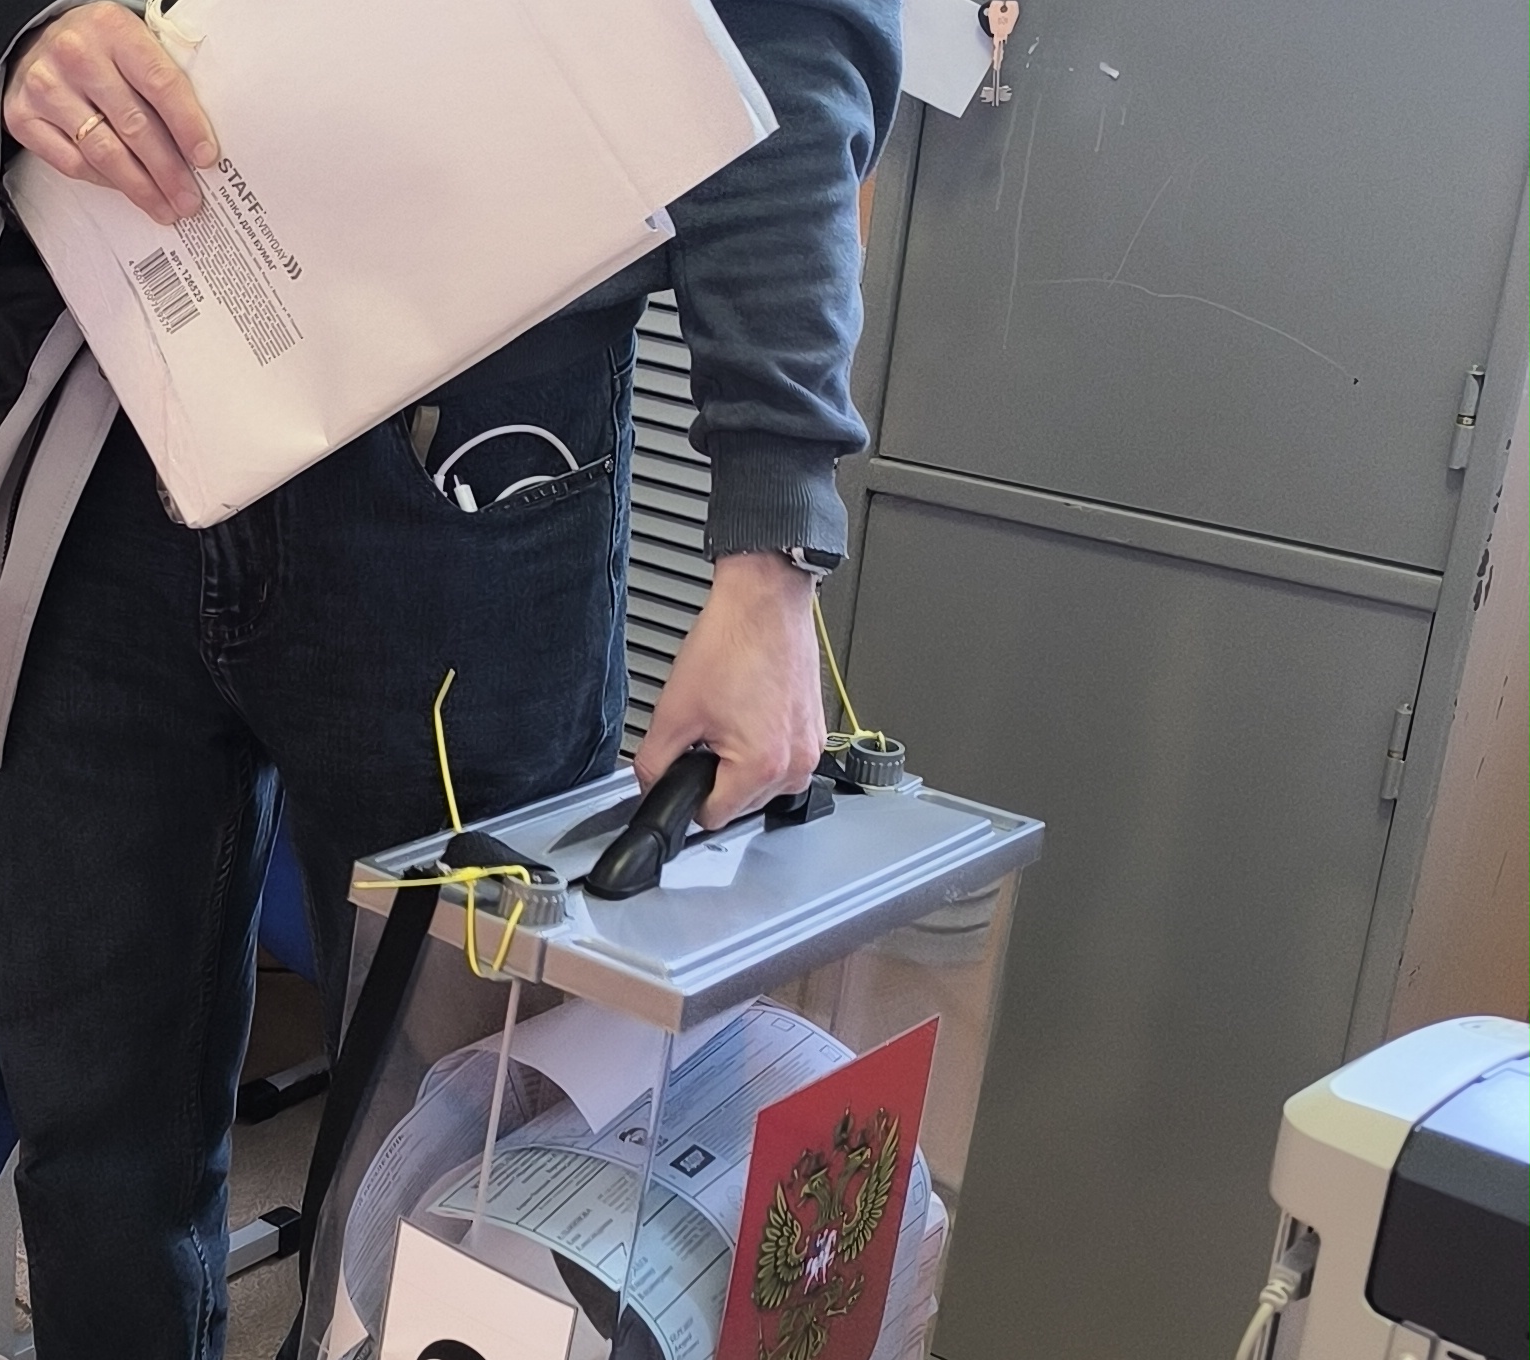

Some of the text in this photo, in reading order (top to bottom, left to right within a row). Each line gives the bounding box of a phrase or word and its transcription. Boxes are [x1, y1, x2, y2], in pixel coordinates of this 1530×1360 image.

[218, 158, 264, 214] STAFF
[219, 186, 277, 271] ПАПКА ДЛЯ БУМАГ
